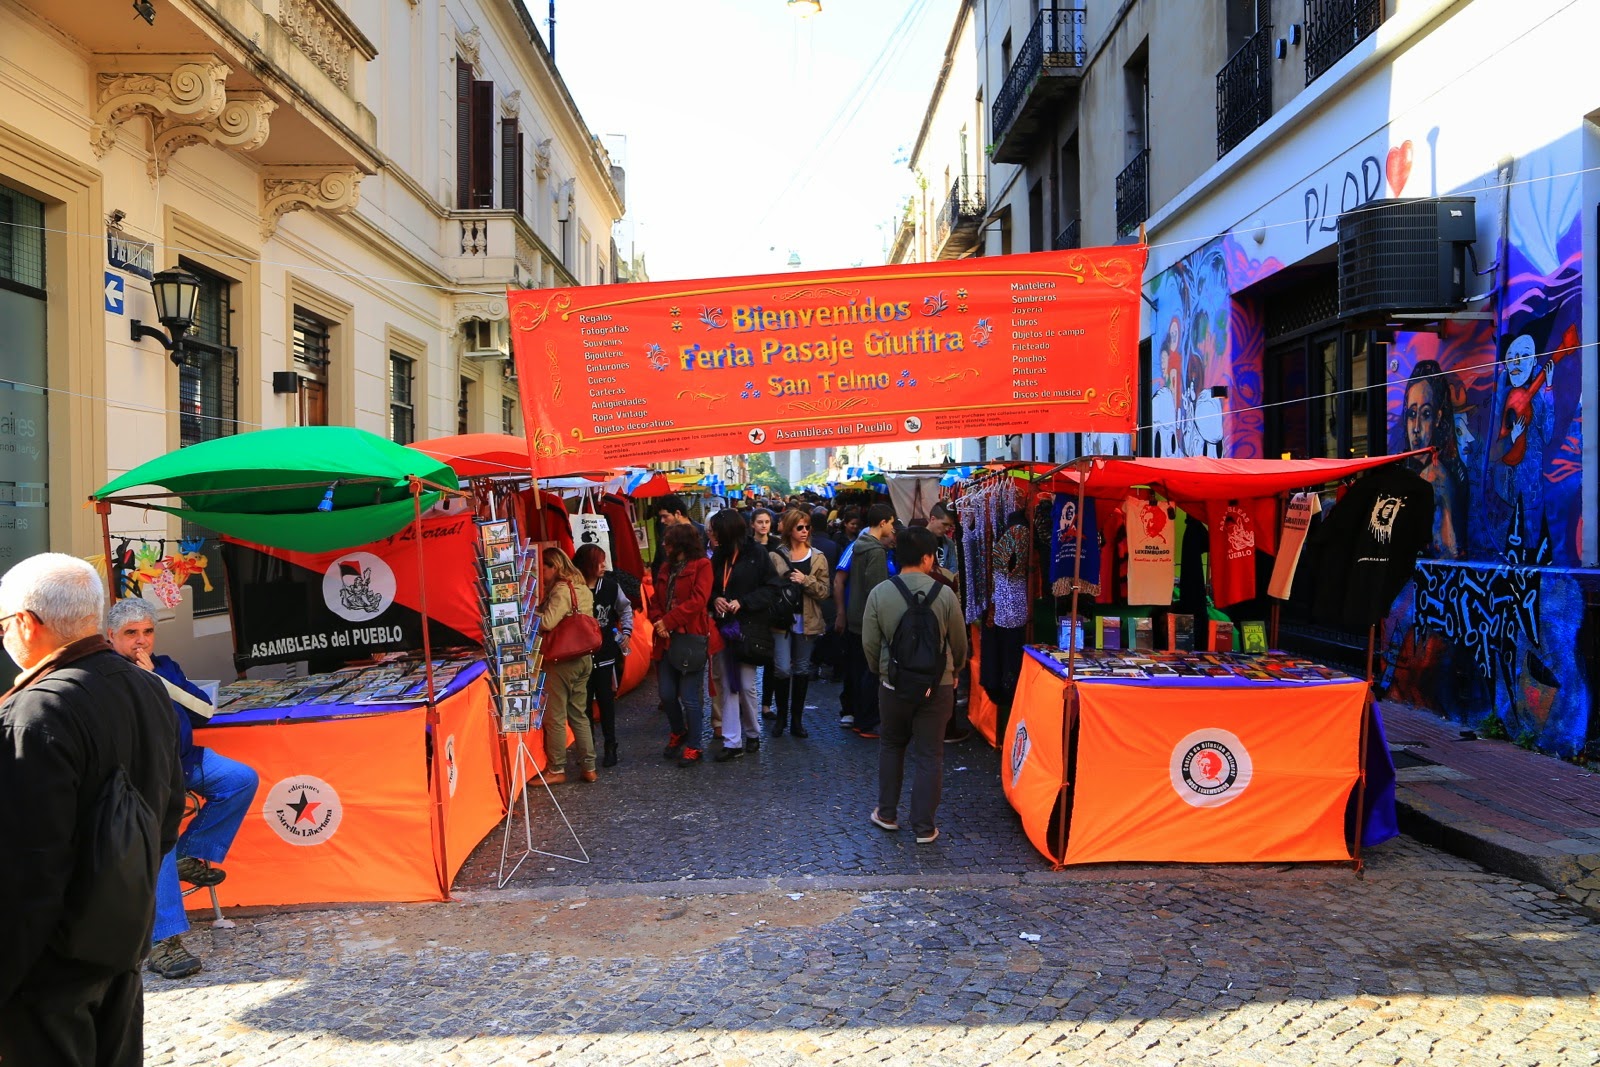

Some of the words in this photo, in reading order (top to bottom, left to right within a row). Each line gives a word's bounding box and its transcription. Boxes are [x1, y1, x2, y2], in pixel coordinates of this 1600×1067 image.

[1012, 294, 1056, 304] Sombreros
[579, 314, 612, 324] Regalos
[732, 296, 912, 333] Bienvenidos
[1012, 319, 1038, 327] Libros
[1012, 330, 1042, 340] Objetos
[1058, 328, 1085, 338] campo
[583, 338, 622, 348] Souvenirs
[678, 342, 754, 370] Feria
[760, 334, 854, 366] Pasaje
[864, 326, 964, 357] Giuffra
[1012, 342, 1050, 351] Fileteado
[584, 350, 624, 361] Bijouterie
[1012, 354, 1046, 363] Ponchos
[586, 362, 630, 373] Cinturones
[1012, 367, 1046, 375] Pinturas
[588, 376, 616, 385] Cueros
[767, 374, 811, 397] San
[818, 369, 890, 393] Telmo
[1013, 379, 1038, 387] Mates
[590, 387, 626, 397] Carteras
[1013, 391, 1038, 400] Discos
[592, 413, 614, 422] Ropa
[616, 409, 648, 419] Vintage
[594, 424, 624, 434] Objetos
[627, 419, 674, 430] decorativos
[776, 424, 834, 440] Asambleas
[837, 422, 854, 436] del
[856, 420, 893, 434] Pueblo
[399, 521, 465, 541] Liertad!
[1227, 550, 1252, 560] UEBLO
[251, 633, 328, 658] ASAMBLEAS
[331, 630, 350, 647] del
[352, 626, 403, 646] PUEBLO
[1183, 752, 1194, 772] Centro
[1225, 752, 1236, 777] Cultural
[288, 783, 320, 794] ediciones
[276, 809, 300, 836] Estrella
[302, 809, 332, 837] Libertaria
